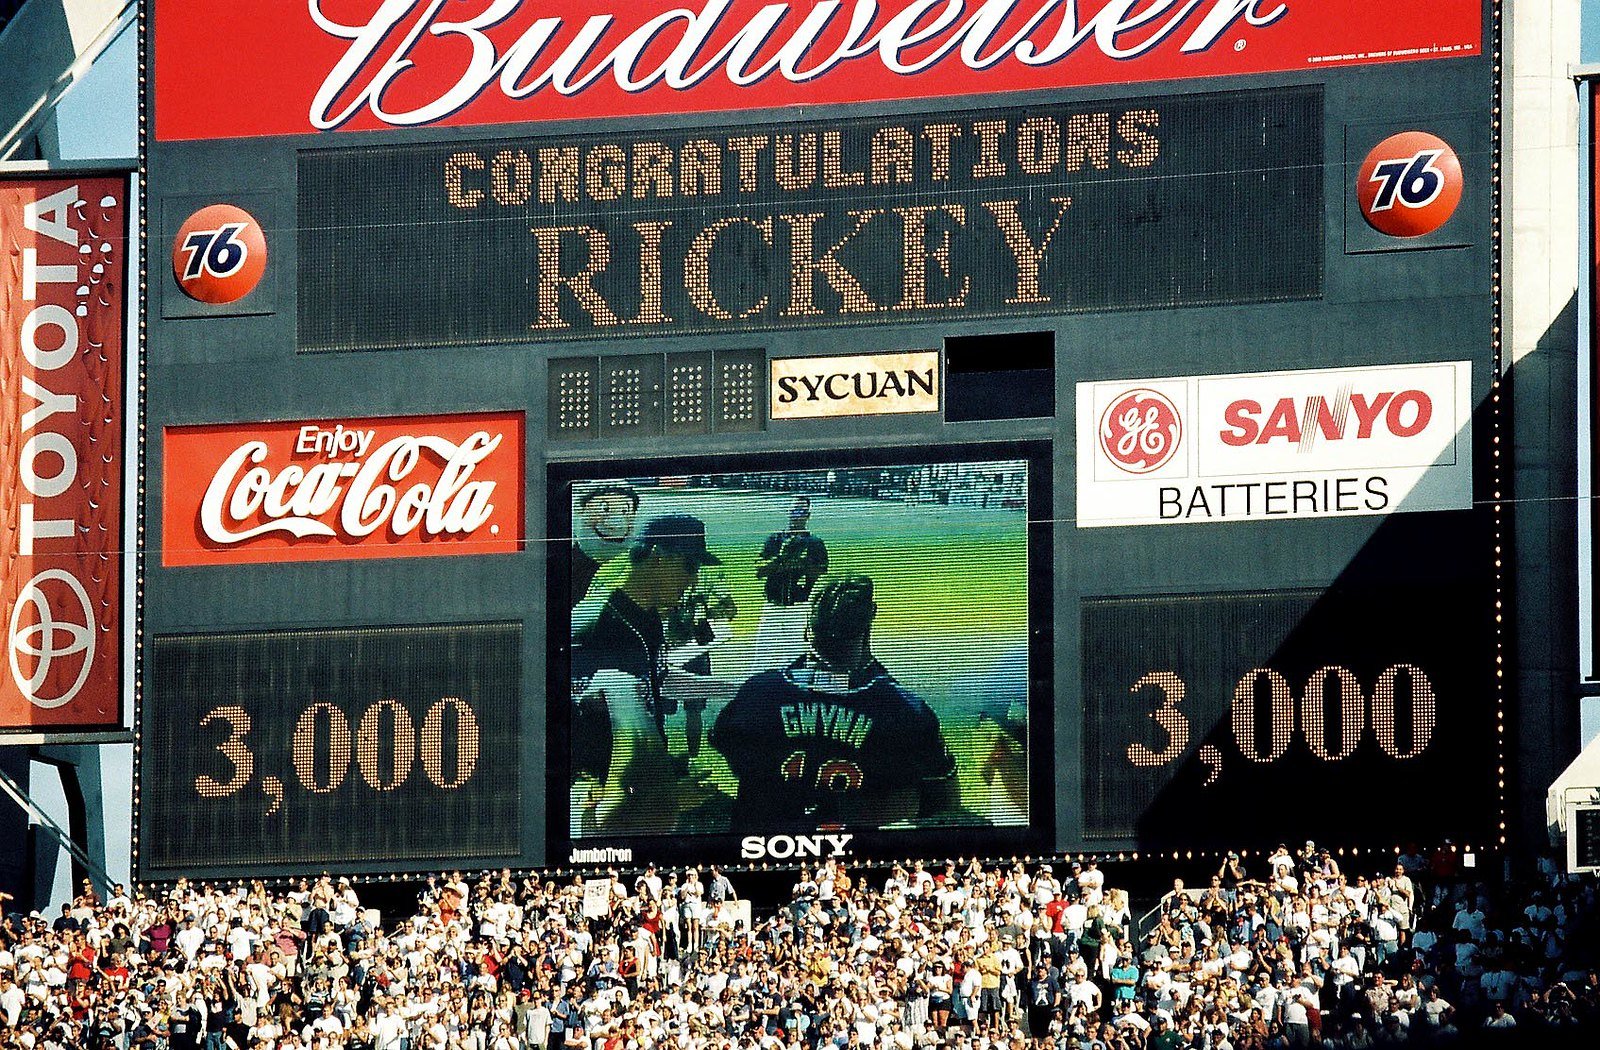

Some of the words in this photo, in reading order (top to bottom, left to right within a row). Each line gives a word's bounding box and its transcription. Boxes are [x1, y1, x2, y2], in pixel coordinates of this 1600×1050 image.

[308, 0, 1288, 131] Budweiser
[445, 107, 1161, 208] CONGRATULATIONS
[1369, 149, 1446, 213] 76
[181, 222, 250, 282] 76
[529, 196, 1073, 329] RICKEY
[19, 184, 79, 556] TOYOTA
[777, 367, 934, 405] SYCUAN
[296, 425, 376, 457] Enjoy
[1219, 383, 1433, 453] SANYO
[1158, 477, 1390, 519] BATTERIES
[195, 697, 480, 816] 3,000
[1126, 664, 1437, 788] 3,000
[569, 847, 632, 863] JumboTron
[741, 834, 853, 859] SONY
